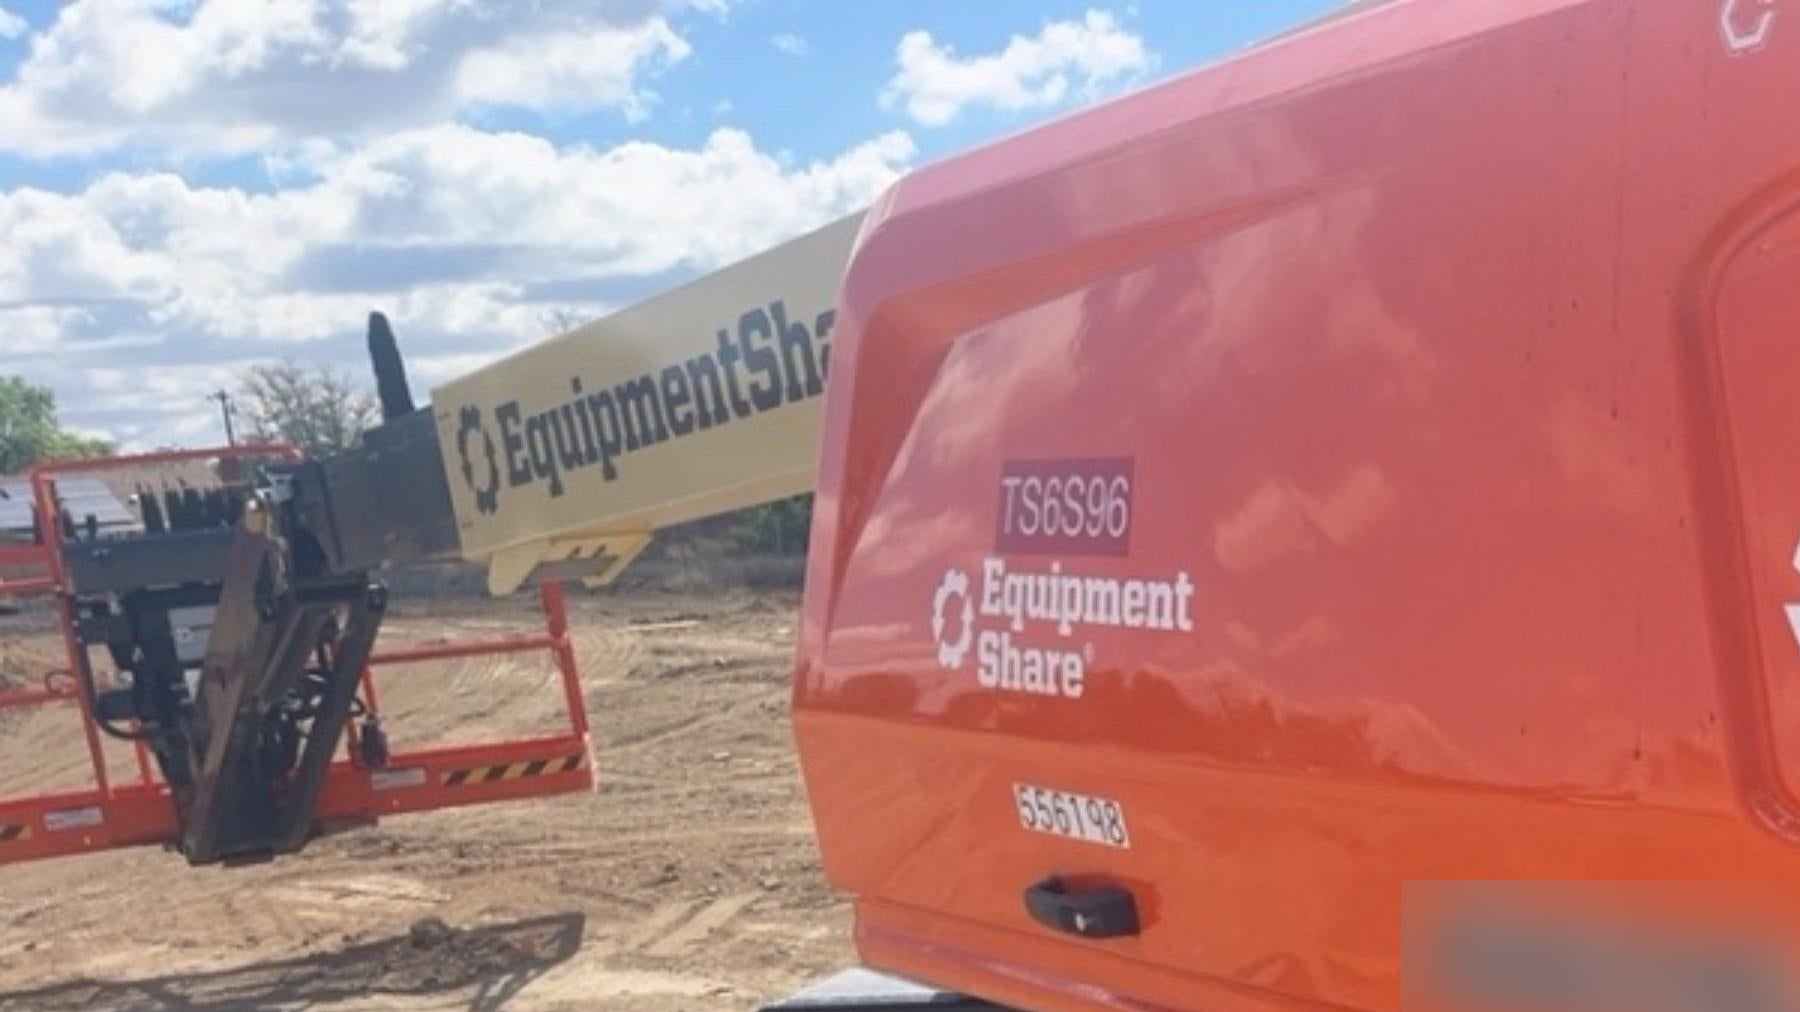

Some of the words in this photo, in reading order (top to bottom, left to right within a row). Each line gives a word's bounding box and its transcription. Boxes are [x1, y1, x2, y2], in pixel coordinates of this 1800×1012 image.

[1002, 475, 1130, 538] TS6S96
[981, 558, 1195, 636] Equipment
[1019, 785, 1126, 845] 556198
